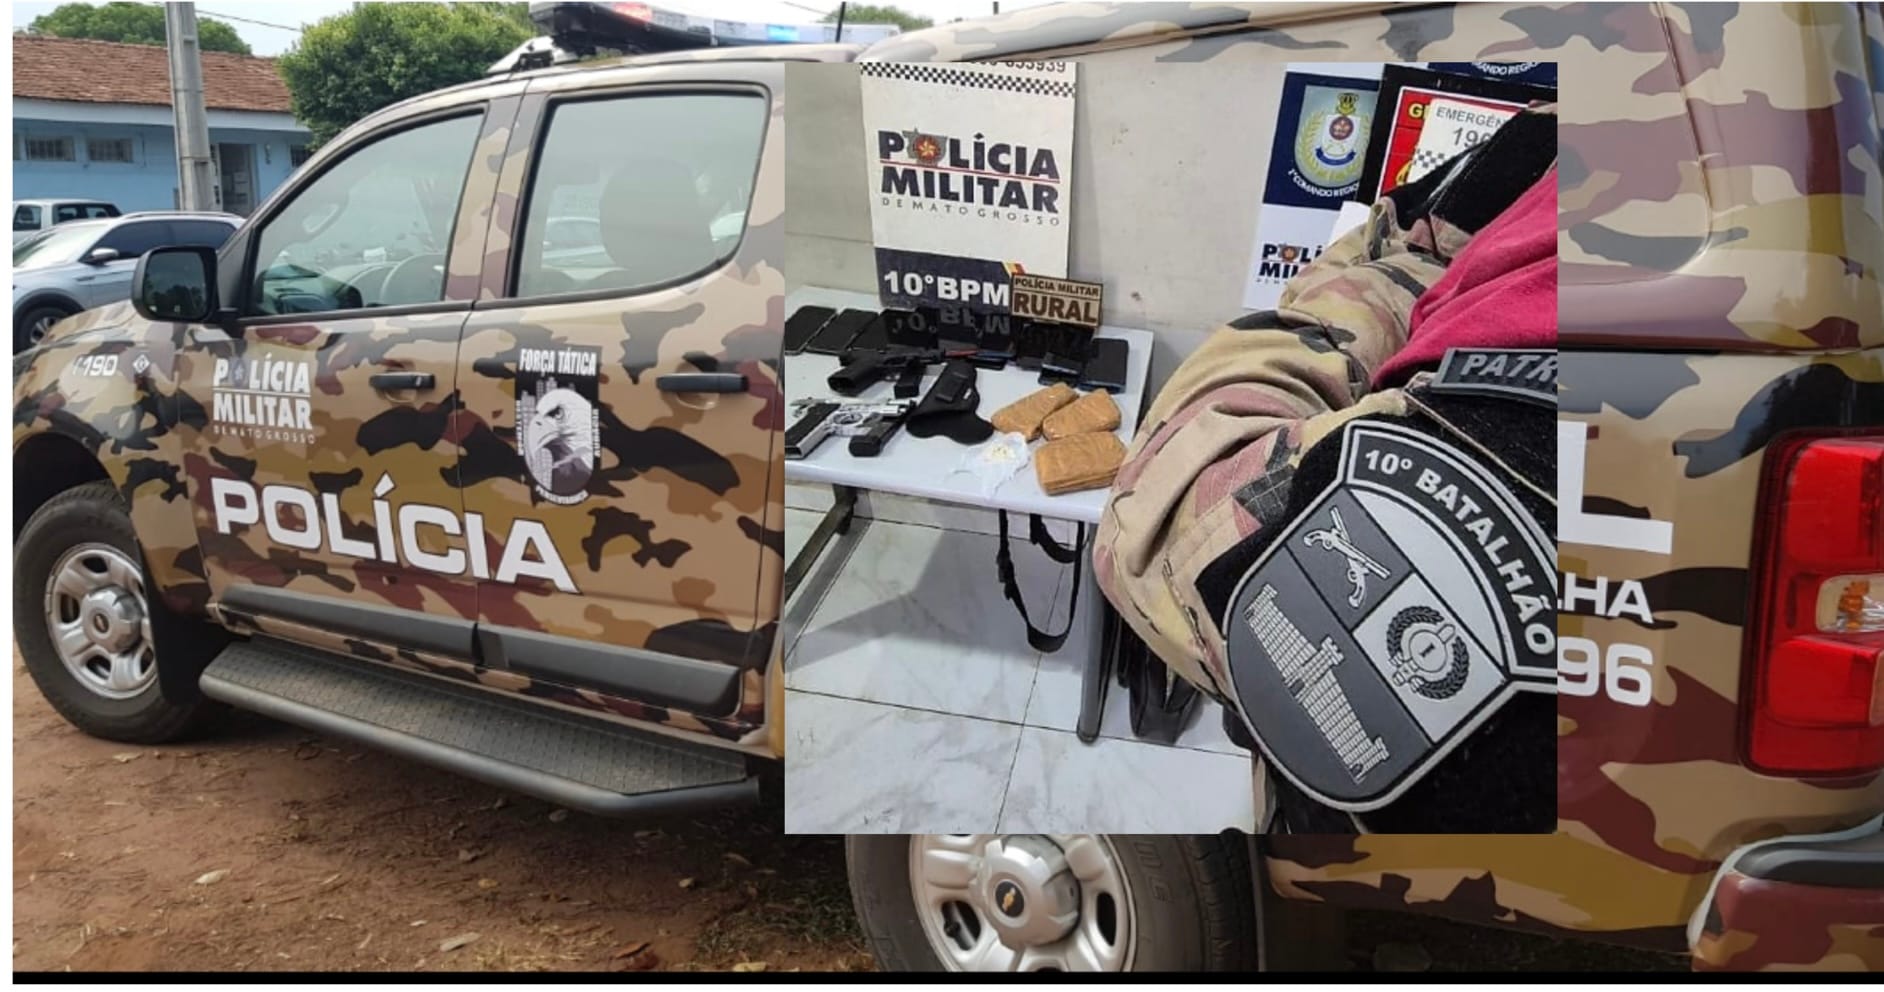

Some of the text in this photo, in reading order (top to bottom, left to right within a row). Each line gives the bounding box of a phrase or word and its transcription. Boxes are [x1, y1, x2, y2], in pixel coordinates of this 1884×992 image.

[881, 167, 1059, 214] MILITAR
[882, 198, 1060, 226] DE MATO GROSSO
[1015, 278, 1099, 297] POLÍCIA MILITAR
[1013, 292, 1097, 324] RURAL
[519, 348, 597, 376] FORÇA TÁTICA
[213, 392, 313, 430] MILITAR
[210, 473, 584, 594] POLÍCIA
[1415, 468, 1556, 655] BATALHÃO
